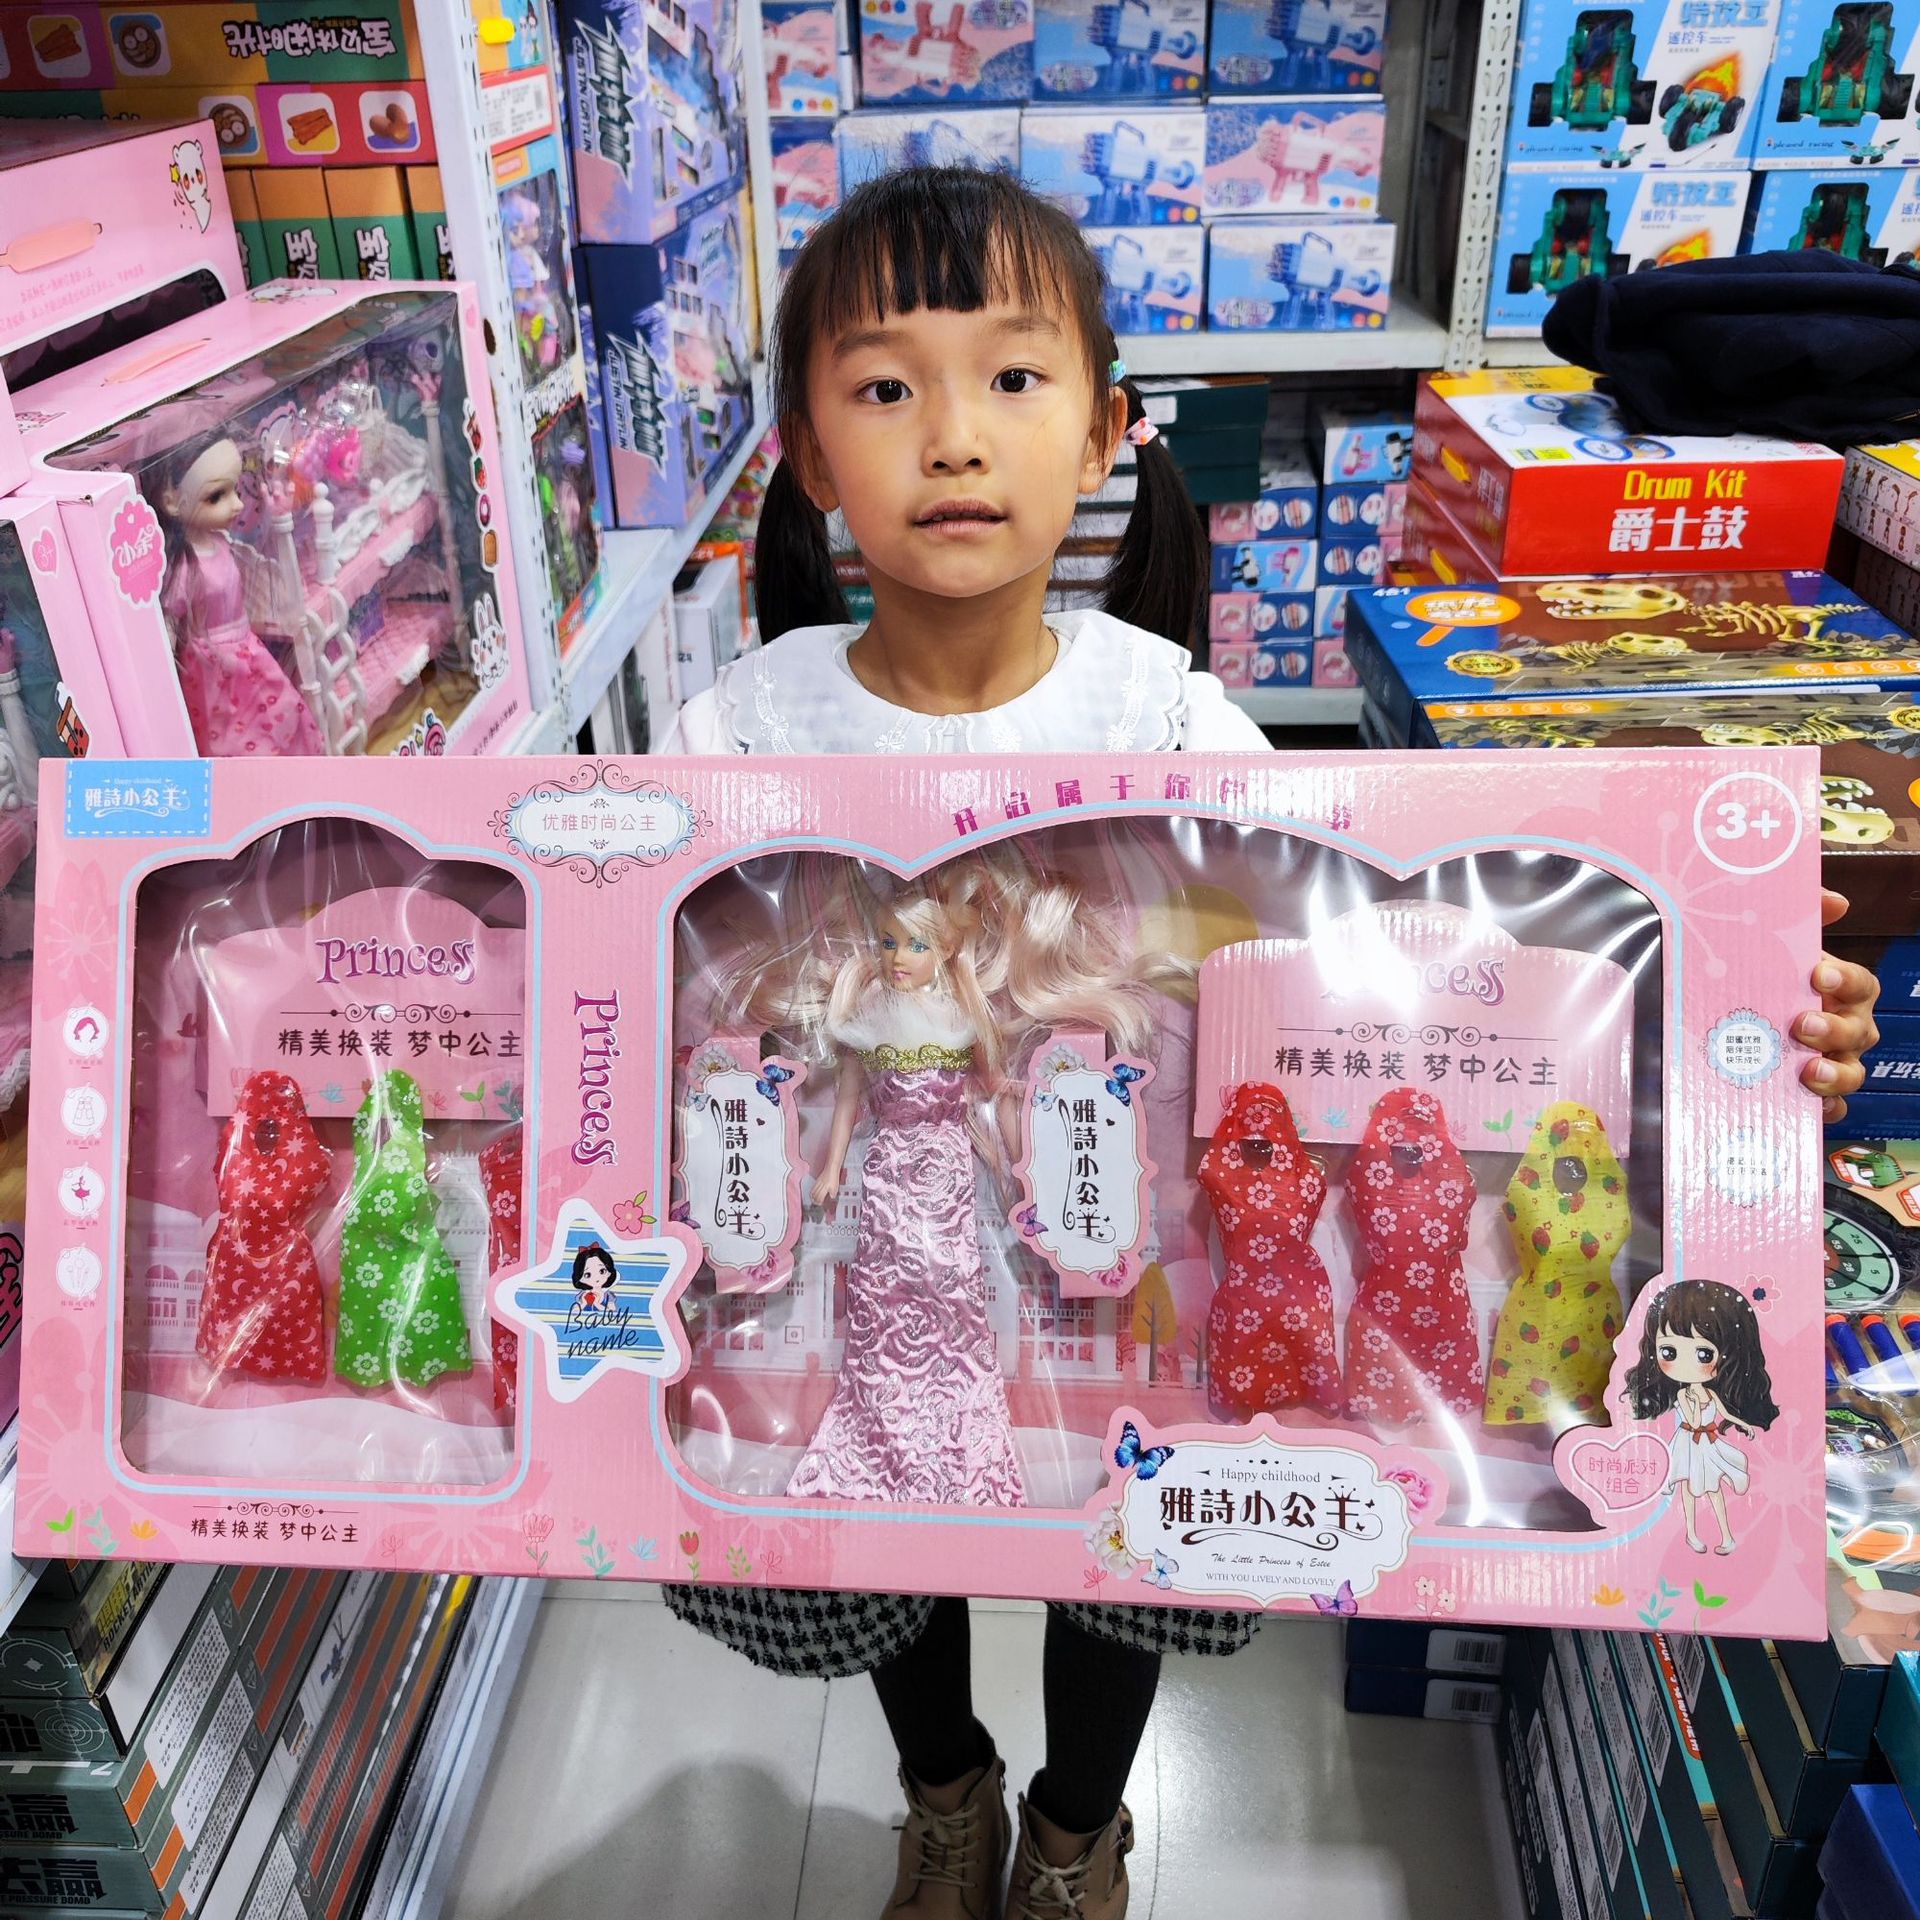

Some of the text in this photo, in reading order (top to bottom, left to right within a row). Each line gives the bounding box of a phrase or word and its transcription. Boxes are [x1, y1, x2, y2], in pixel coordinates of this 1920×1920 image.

[223, 18, 395, 57] 宝贝休闲时光
[1624, 468, 1748, 501] Drum Kit
[1608, 505, 1749, 553] 爵士鼓
[542, 813, 657, 832] 优雅时尚公主
[1716, 801, 1781, 840] 3+
[315, 936, 477, 985] Princess
[278, 1028, 523, 1058] 精美换装 梦中公主
[571, 988, 623, 1167] Princess
[1274, 1046, 1559, 1086] 精美换装 梦中公主
[723, 1098, 751, 1235] 雅詩小公主
[1072, 1098, 1101, 1238] 雅詩小公主
[564, 1299, 634, 1334] Baby
[567, 1329, 639, 1359] name
[1220, 1467, 1321, 1484] Happy childhood
[1589, 1456, 1658, 1476] 时尚派对
[1606, 1477, 1640, 1494] 组合
[1159, 1485, 1361, 1531] 雅詩小公主
[190, 1518, 359, 1543] 精美换装 梦中公主
[1211, 1553, 1227, 1563] The
[1231, 1553, 1254, 1564] Little
[1258, 1555, 1292, 1566] Princess
[1296, 1559, 1304, 1568] of
[1206, 1573, 1336, 1587] WITH YOU LIVELY AND LOVELY
[103, 1597, 136, 1651] ROCKET
